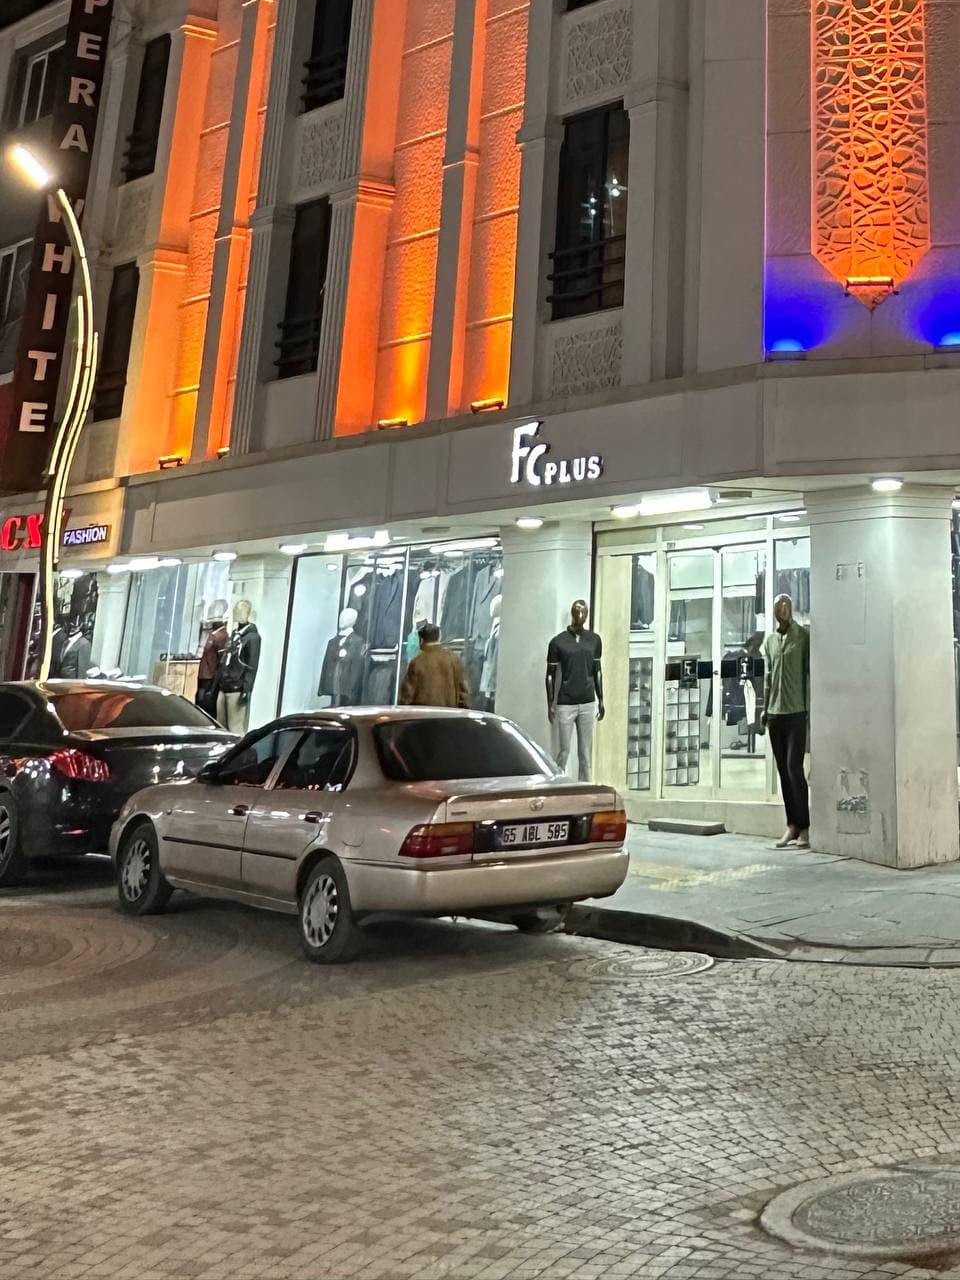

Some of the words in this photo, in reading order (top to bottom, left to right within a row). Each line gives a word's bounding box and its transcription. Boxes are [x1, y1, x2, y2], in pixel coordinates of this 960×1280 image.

[18, 194, 85, 432] WHITE
[544, 455, 603, 485] PLUS
[62, 525, 108, 545] FASHION
[503, 828, 517, 843] 65
